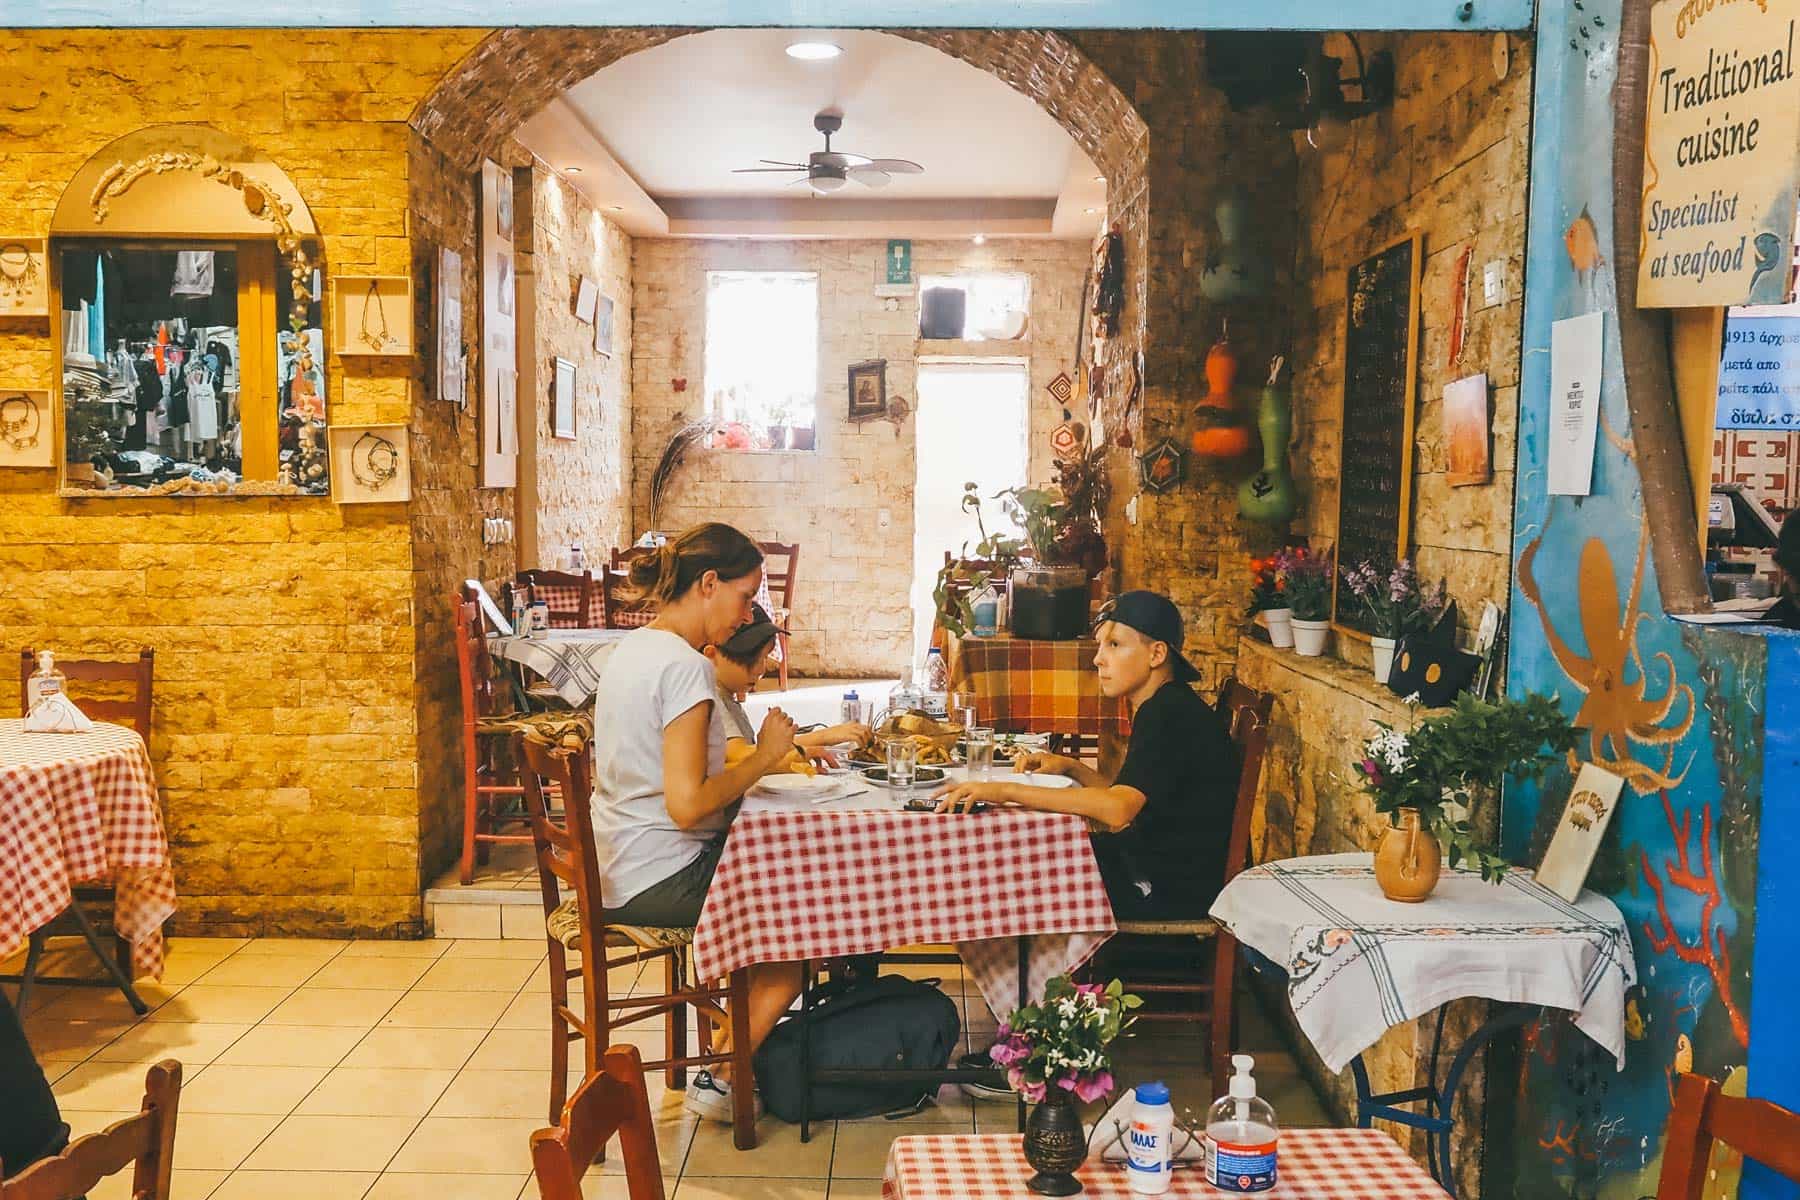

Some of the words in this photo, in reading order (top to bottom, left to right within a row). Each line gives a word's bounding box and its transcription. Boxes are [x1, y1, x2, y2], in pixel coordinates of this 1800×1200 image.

[1660, 20, 1793, 114] Traditional
[1677, 112, 1760, 168] cuisine
[1648, 190, 1739, 239] Specialist
[1650, 255, 1668, 279] at
[1672, 236, 1745, 282] seafood
[1727, 331, 1755, 343] 1913
[1724, 358, 1752, 372] μετά
[1752, 382, 1778, 394] πάλι
